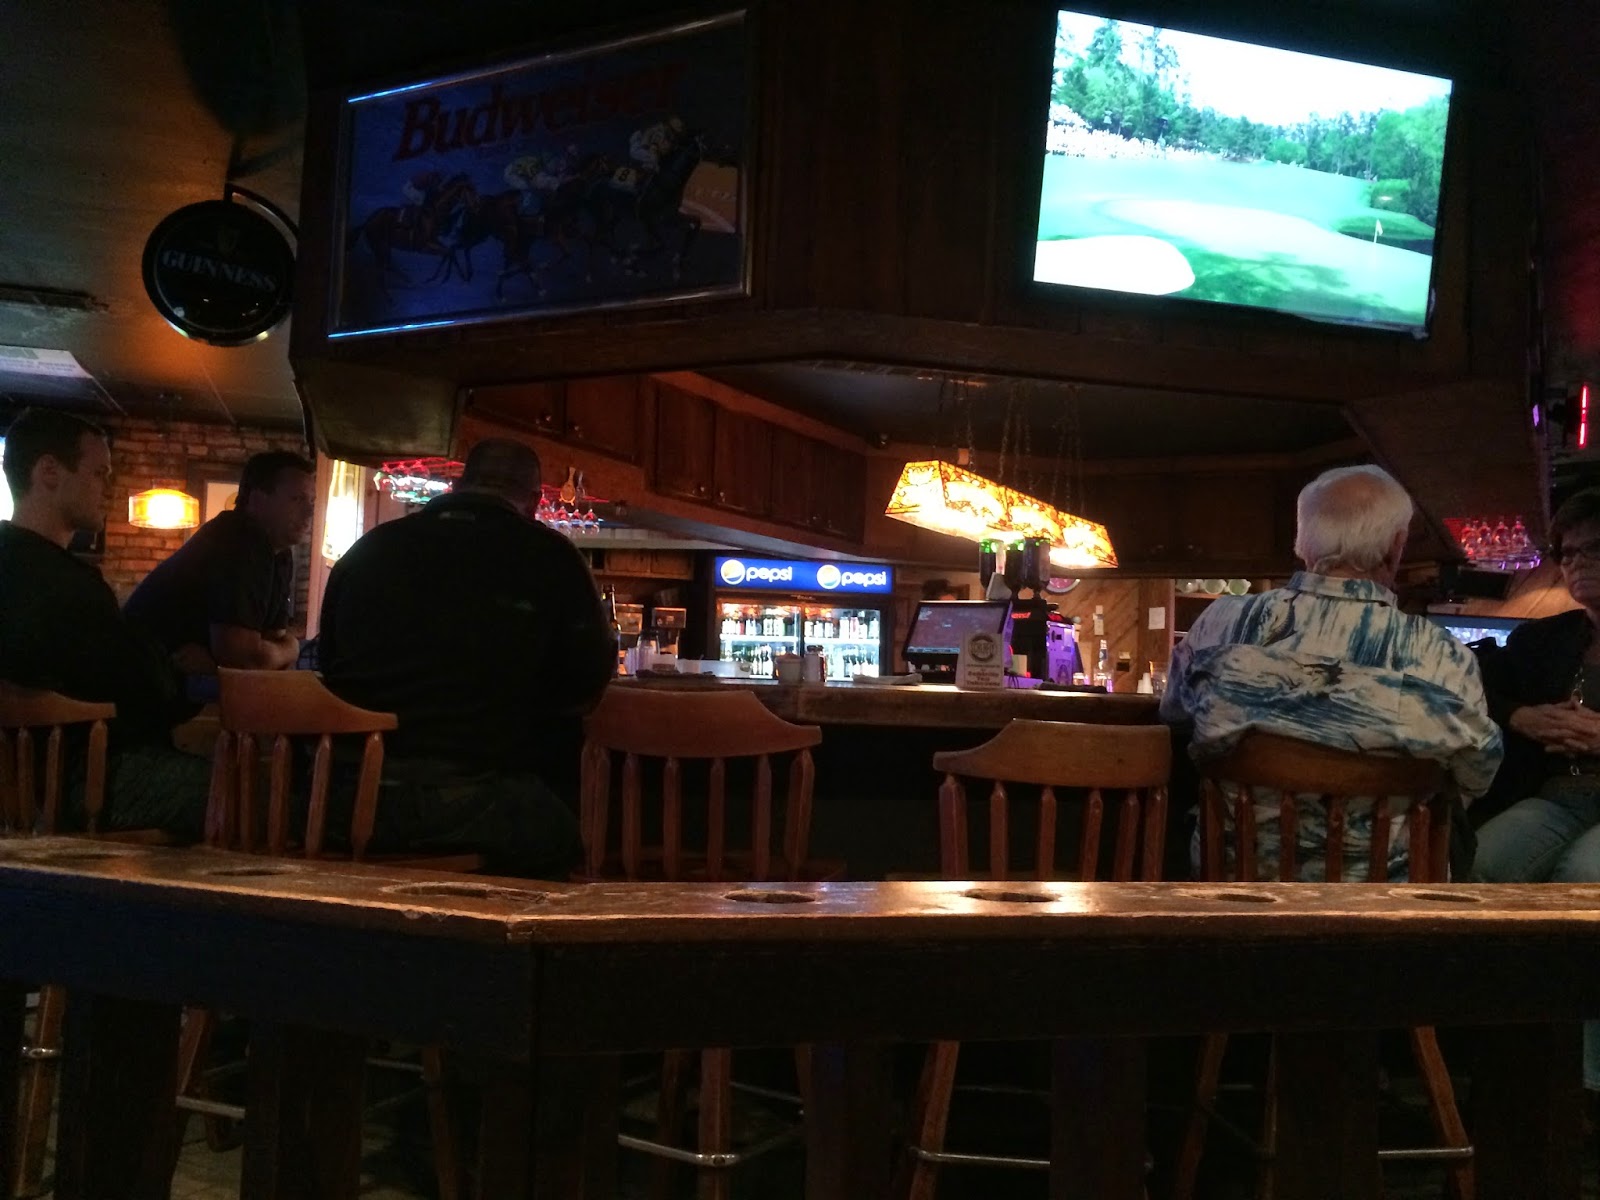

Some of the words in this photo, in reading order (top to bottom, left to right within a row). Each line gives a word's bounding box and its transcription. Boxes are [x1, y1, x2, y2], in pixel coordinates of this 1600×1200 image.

[393, 62, 689, 162] Budweiser
[160, 249, 277, 291] GUINNESS
[746, 566, 793, 583] pepsi
[841, 571, 887, 587] pepsi
